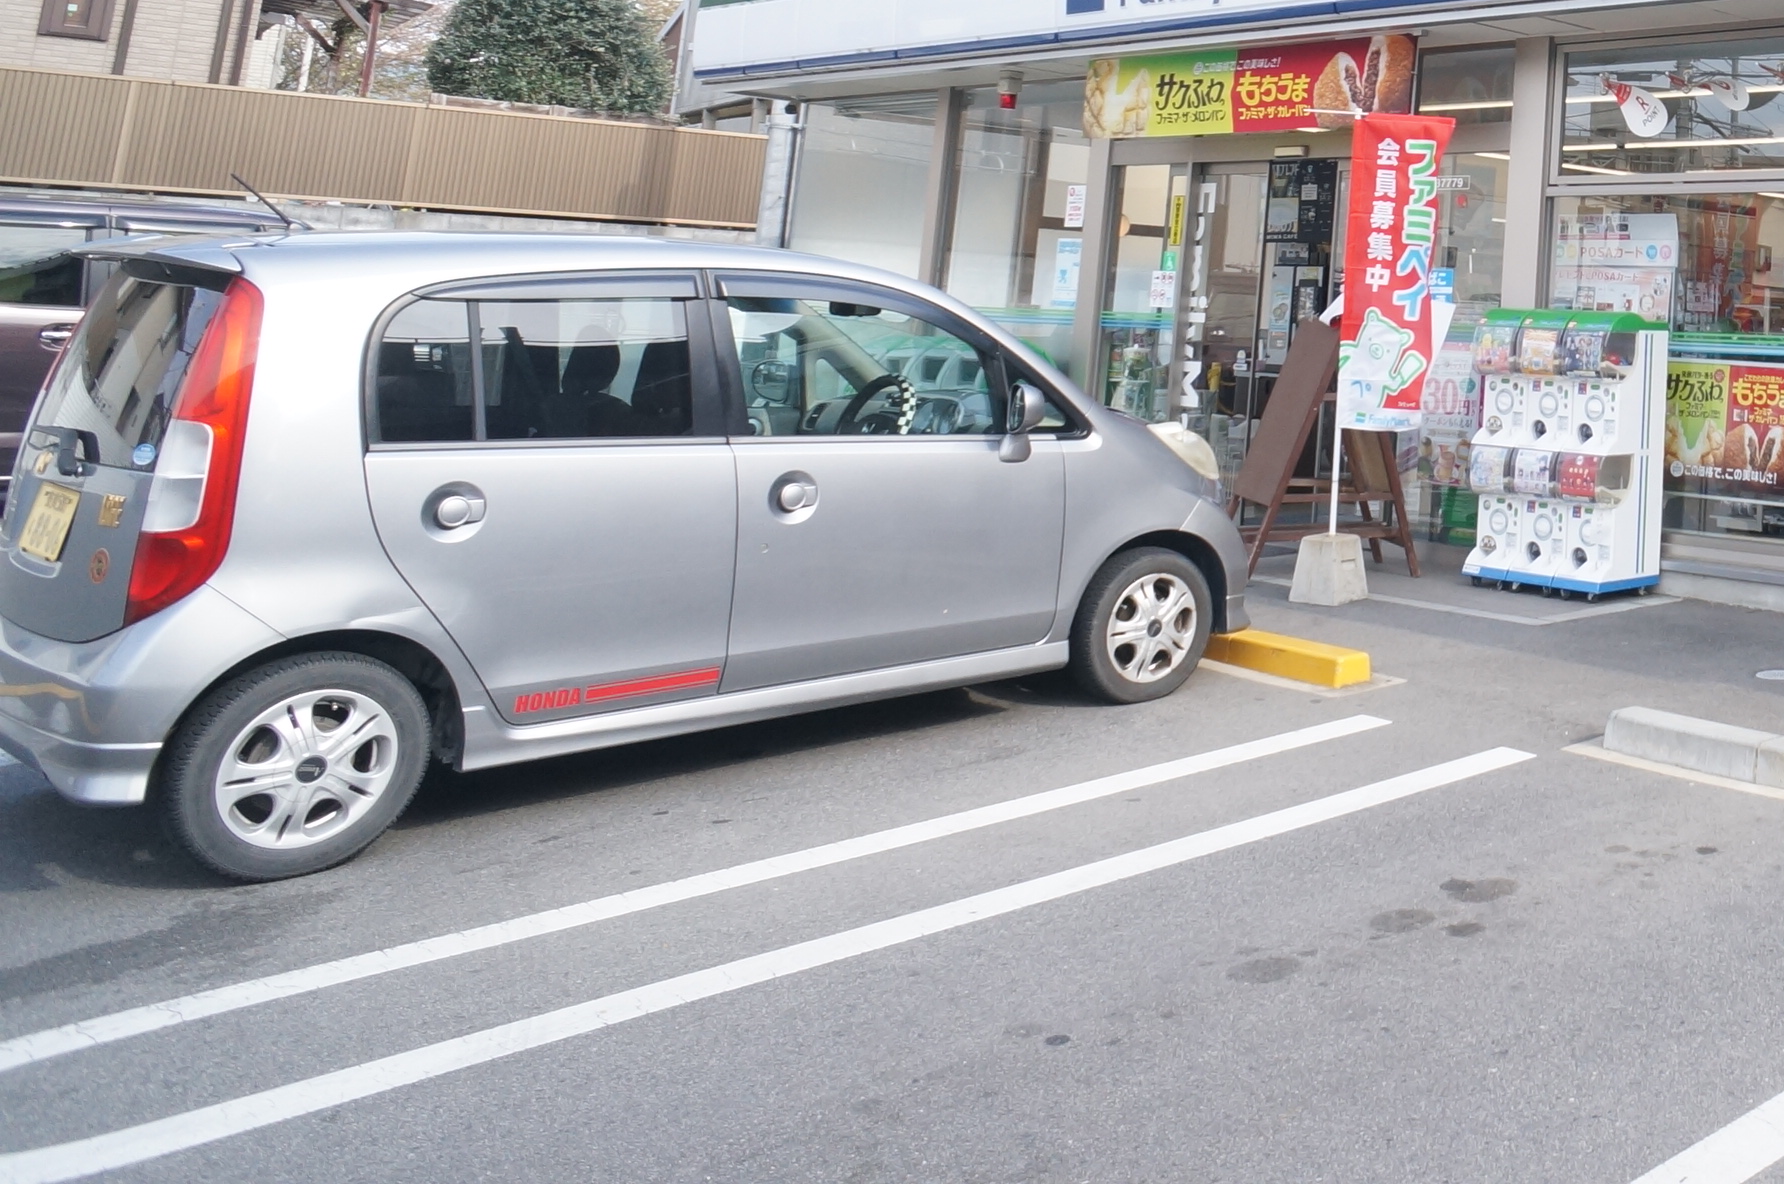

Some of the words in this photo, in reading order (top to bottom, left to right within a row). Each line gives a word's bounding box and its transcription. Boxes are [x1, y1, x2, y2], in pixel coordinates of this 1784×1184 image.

[1236, 71, 1311, 103] もちうま
[1643, 106, 1660, 128] POINT
[1364, 138, 1401, 292] 会員募集中
[1393, 139, 1437, 320] ファミペイ
[1580, 245, 1644, 259] POSAカード
[1368, 413, 1412, 428] FamilyMart
[514, 687, 581, 714] HONDA
